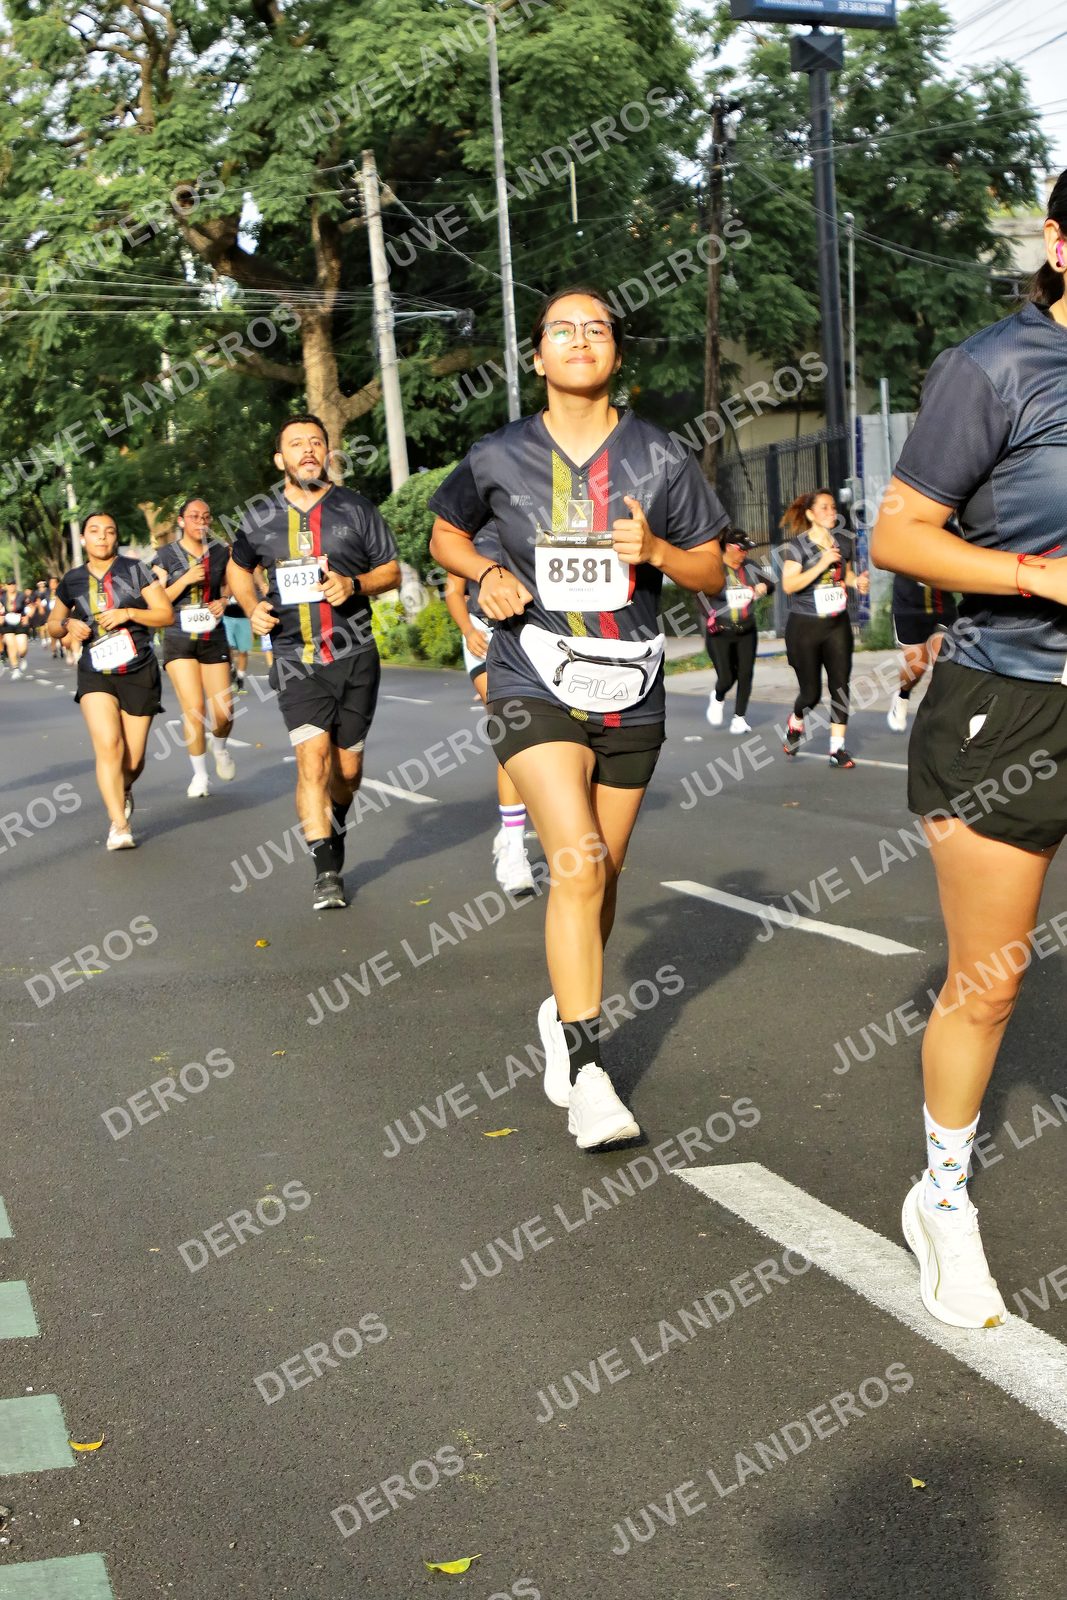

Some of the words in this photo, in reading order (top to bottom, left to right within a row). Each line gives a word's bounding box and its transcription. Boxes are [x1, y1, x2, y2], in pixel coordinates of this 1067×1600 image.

[284, 571, 315, 587] 8433
[549, 558, 612, 583] 8581
[187, 612, 210, 622] 9086
[568, 674, 629, 700] FILA
